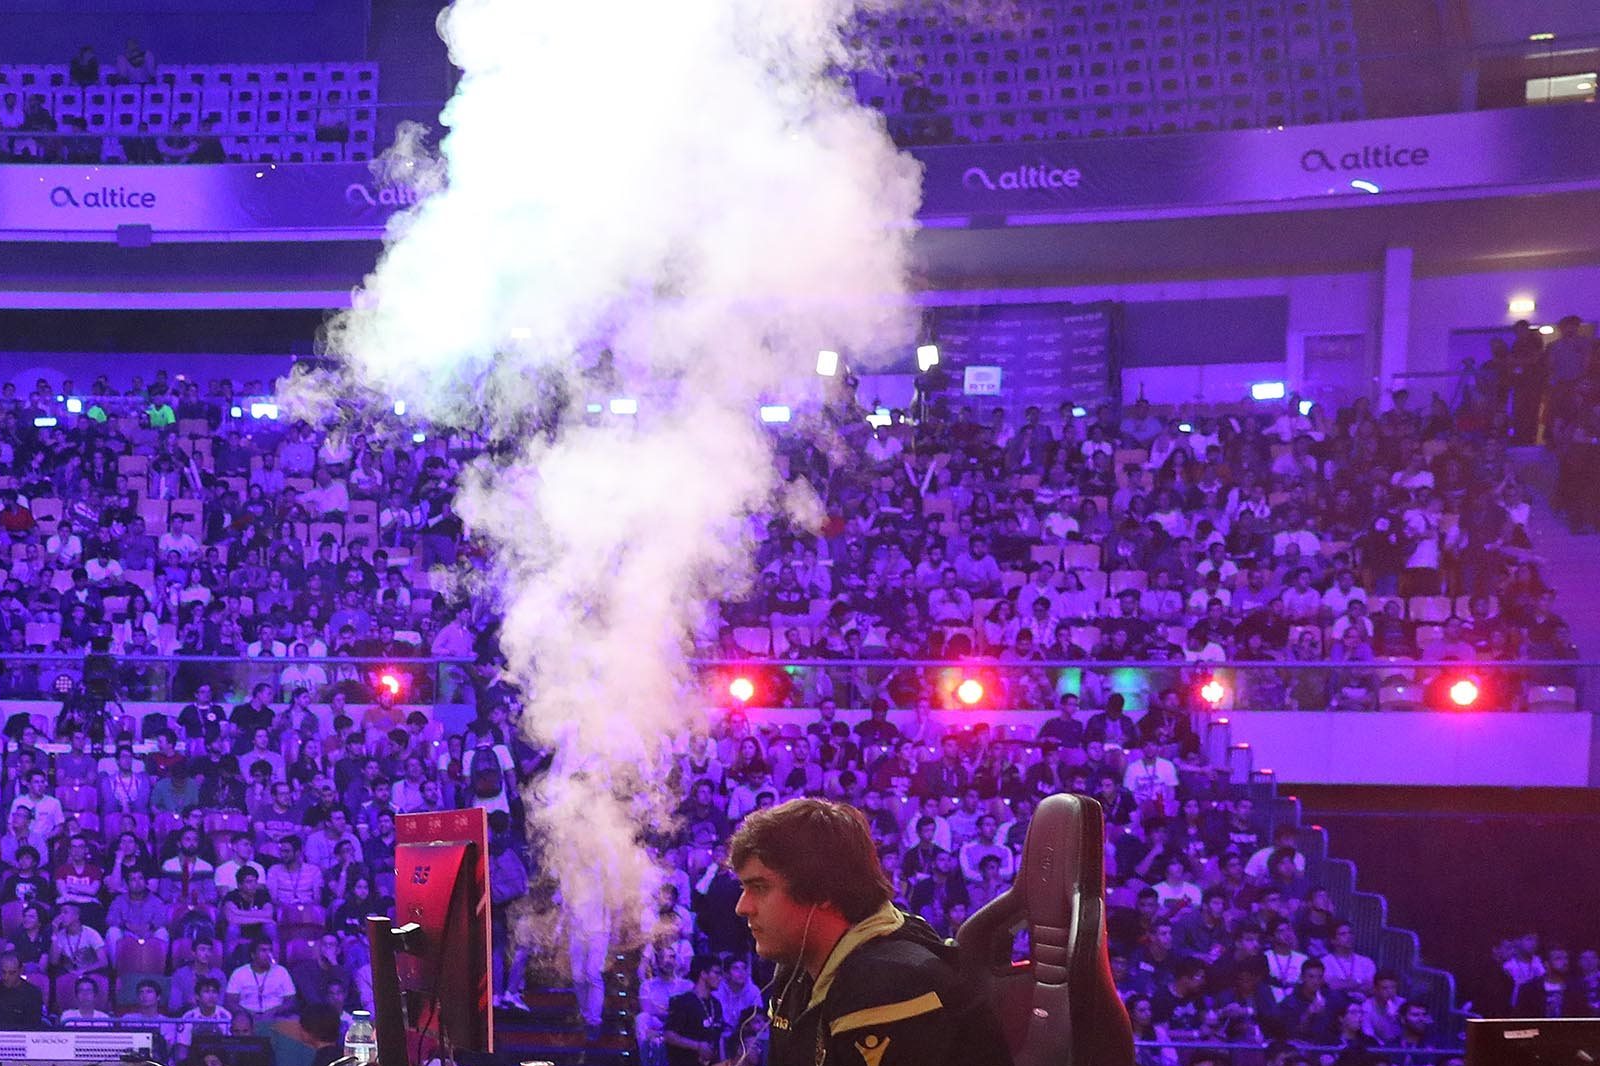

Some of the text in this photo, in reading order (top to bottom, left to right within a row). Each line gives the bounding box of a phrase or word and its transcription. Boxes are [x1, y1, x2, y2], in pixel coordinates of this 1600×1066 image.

[1341, 144, 1429, 170] altice
[999, 165, 1081, 190] altice
[83, 187, 156, 208] altice
